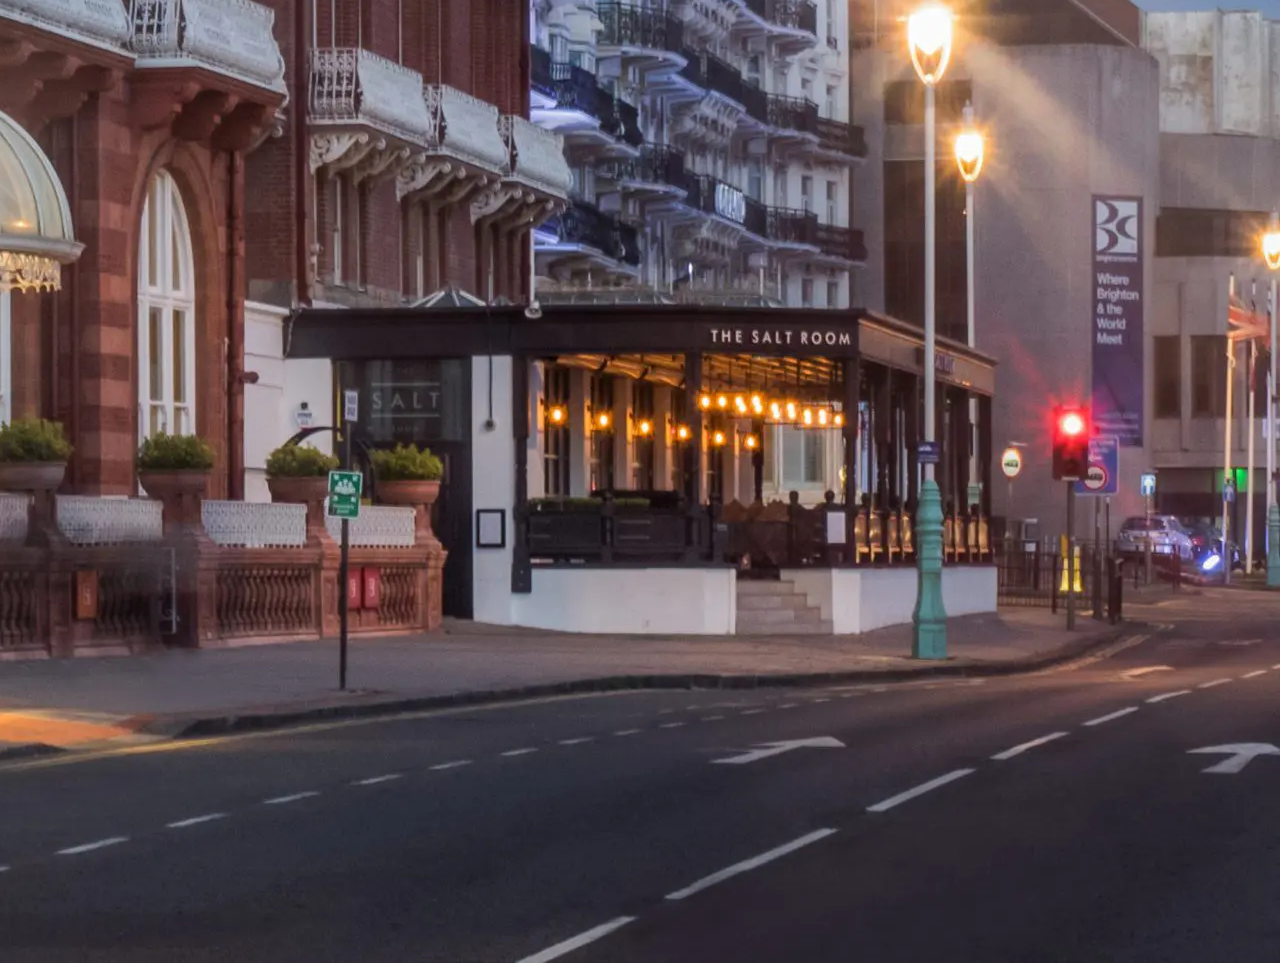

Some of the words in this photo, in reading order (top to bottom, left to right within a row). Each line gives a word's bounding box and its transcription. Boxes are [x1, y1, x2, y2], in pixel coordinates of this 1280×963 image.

[1096, 273, 1129, 286] Where
[1096, 288, 1139, 302] Brighton
[1096, 303, 1105, 315] &
[1107, 303, 1123, 315] the
[1096, 318, 1126, 330] World
[710, 329, 743, 344] THE
[751, 330, 793, 345] SALT
[800, 331, 851, 345] ROOM
[1096, 333, 1123, 345] Meet
[373, 391, 440, 409] SALT
